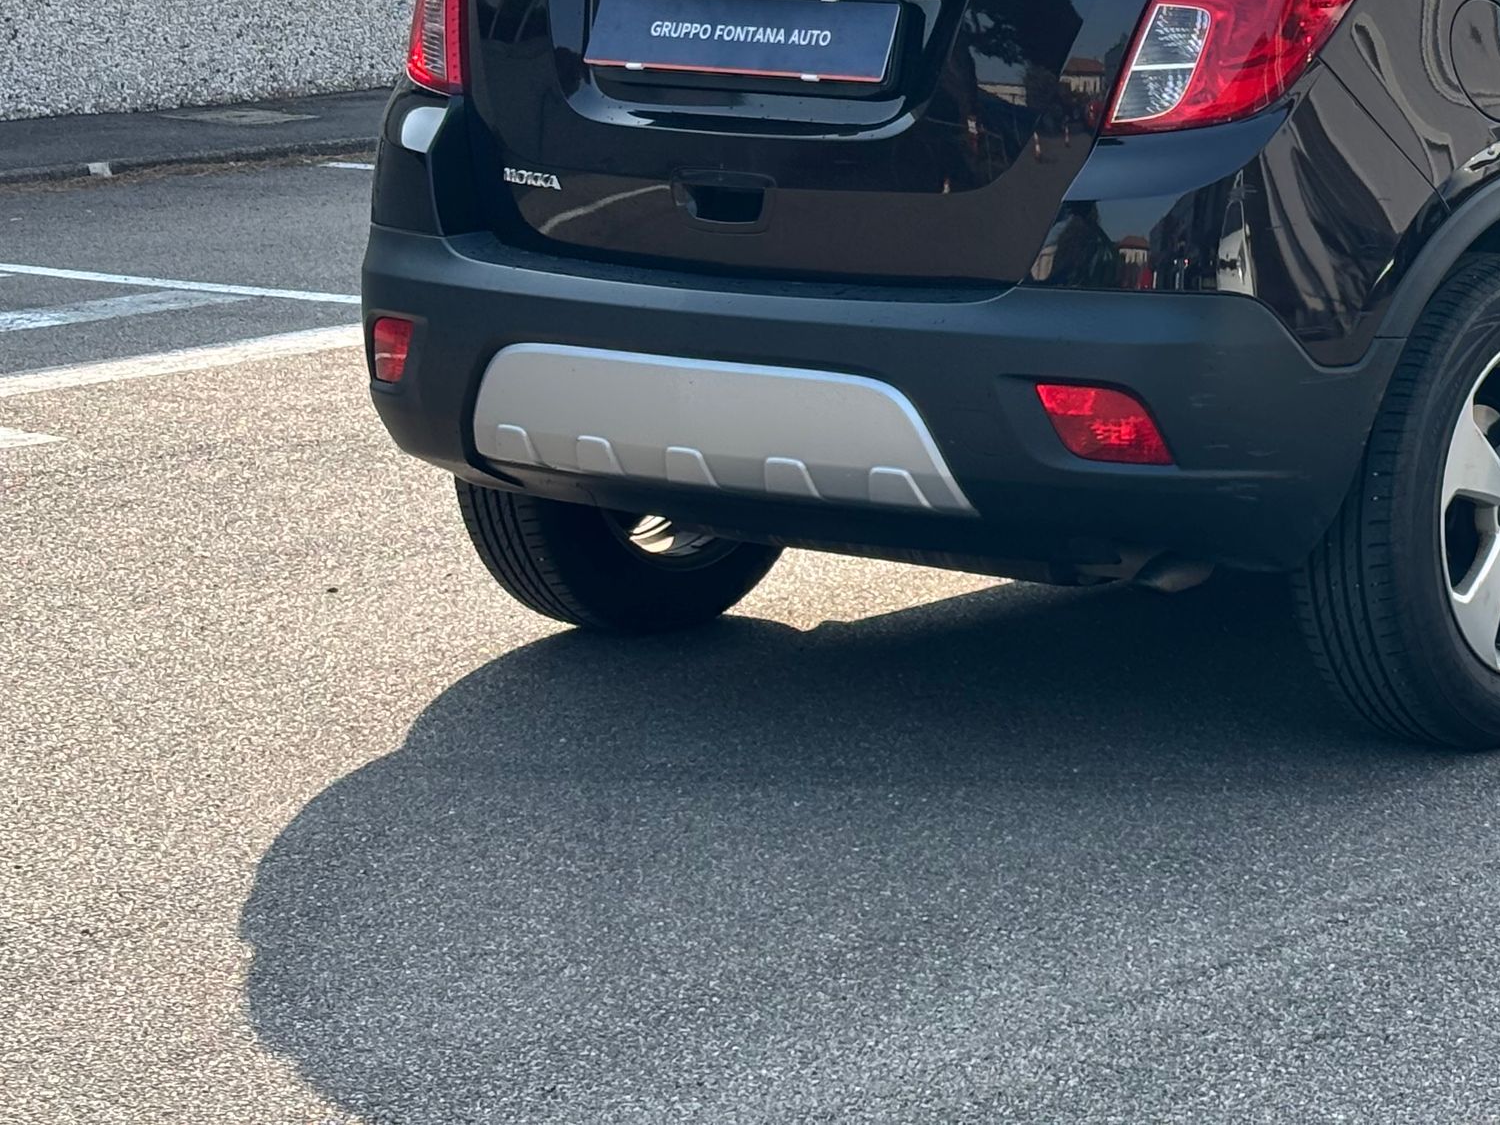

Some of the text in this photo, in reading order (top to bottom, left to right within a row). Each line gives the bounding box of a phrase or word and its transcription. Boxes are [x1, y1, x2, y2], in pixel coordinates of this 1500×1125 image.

[650, 21, 832, 46] GRUPPO FONTANA AUTO
[503, 167, 562, 190] MOKKA
